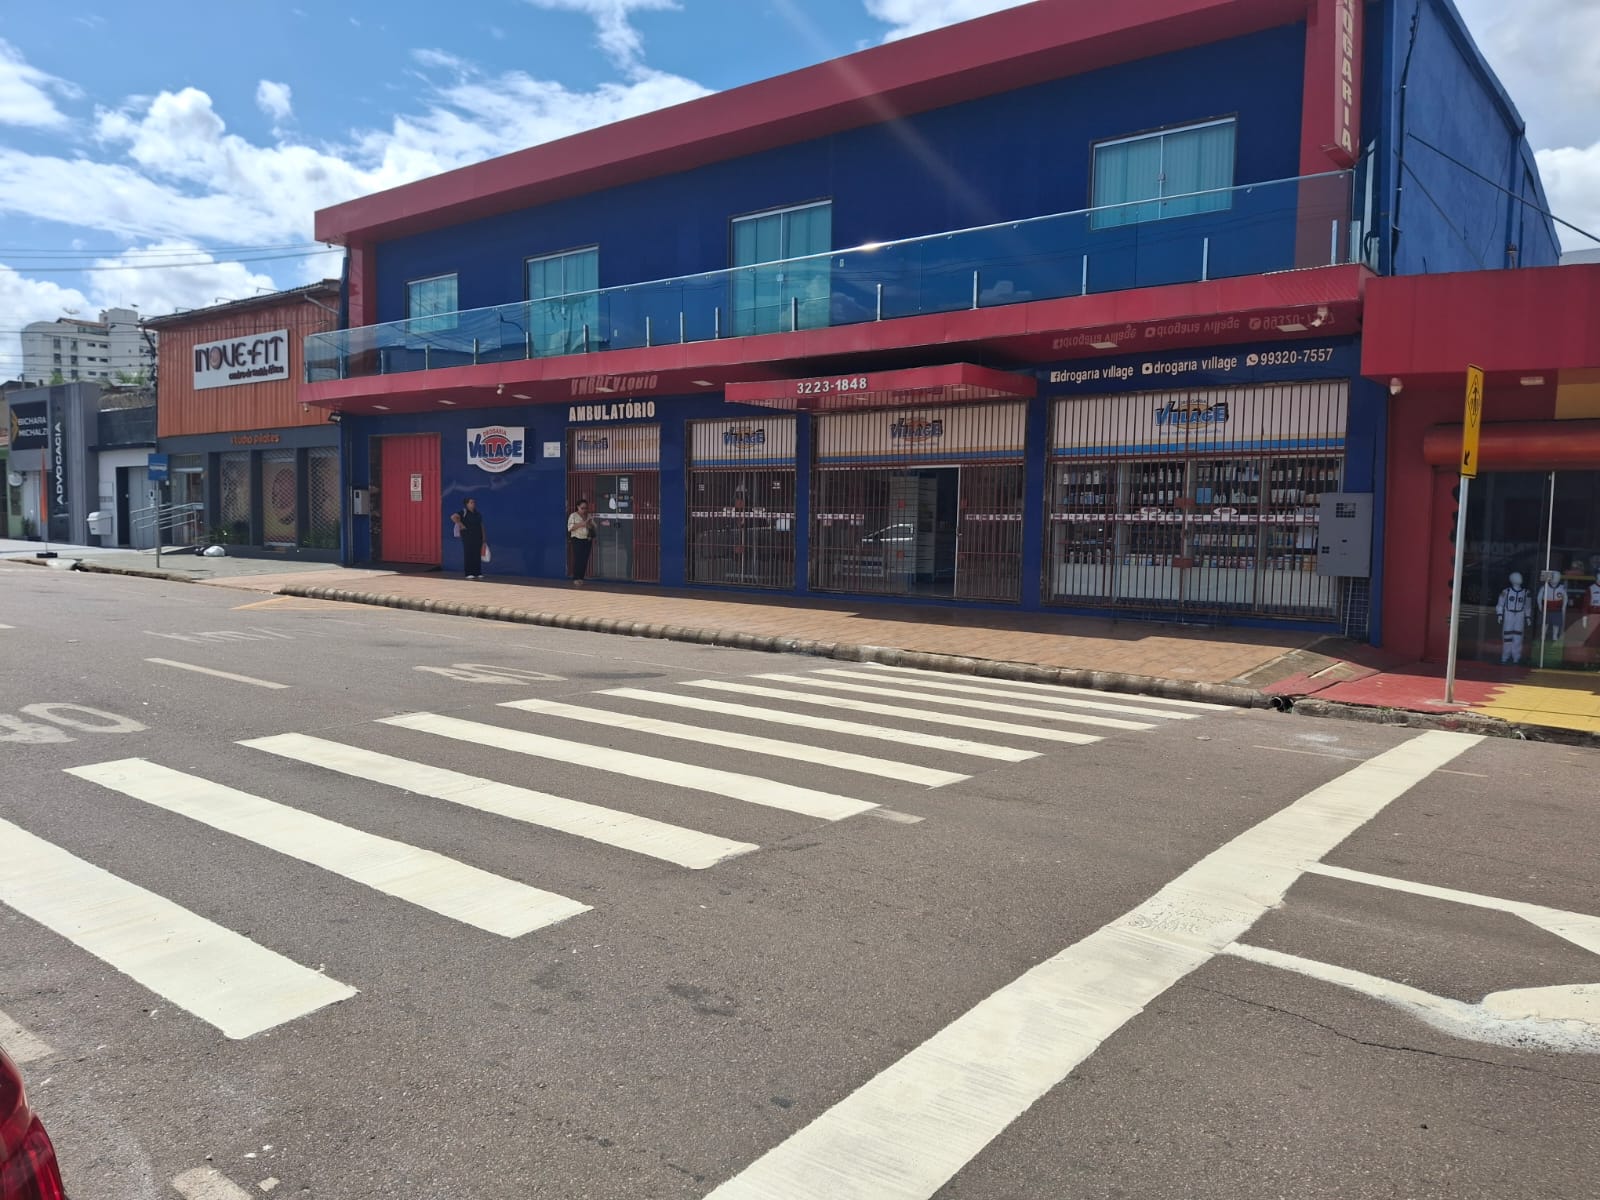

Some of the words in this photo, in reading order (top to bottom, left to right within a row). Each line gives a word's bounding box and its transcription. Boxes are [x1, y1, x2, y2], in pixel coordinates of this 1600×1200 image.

[1154, 360, 1197, 375] drogaria
[1202, 355, 1237, 371] village
[1260, 348, 1333, 366] 99320-7557
[1060, 369, 1100, 384] drogaria
[1103, 365, 1134, 380] village
[797, 377, 867, 394] 3223-1848
[569, 398, 656, 422] AMBULATÓRIO
[468, 433, 522, 459] VILLAGE
[55, 422, 63, 504] ADVOCACIA
